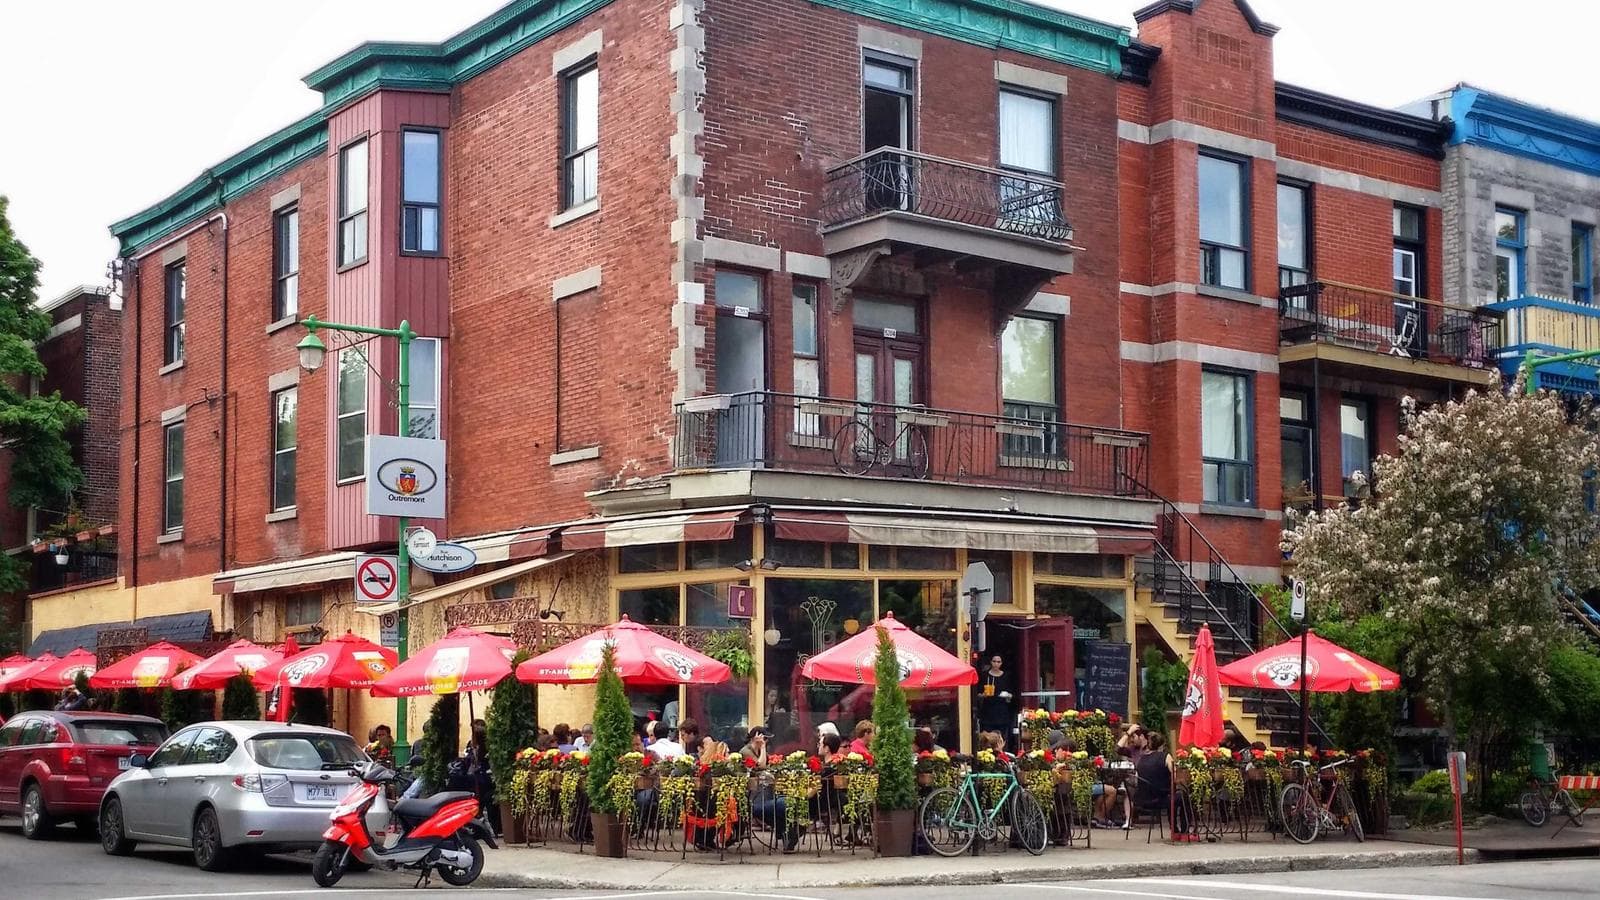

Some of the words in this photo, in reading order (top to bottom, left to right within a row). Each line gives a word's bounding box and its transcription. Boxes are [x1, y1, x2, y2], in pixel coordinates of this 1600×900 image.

[388, 494, 425, 503] Outremont
[456, 679, 489, 689] BLONDE
[323, 788, 336, 797] BLV
